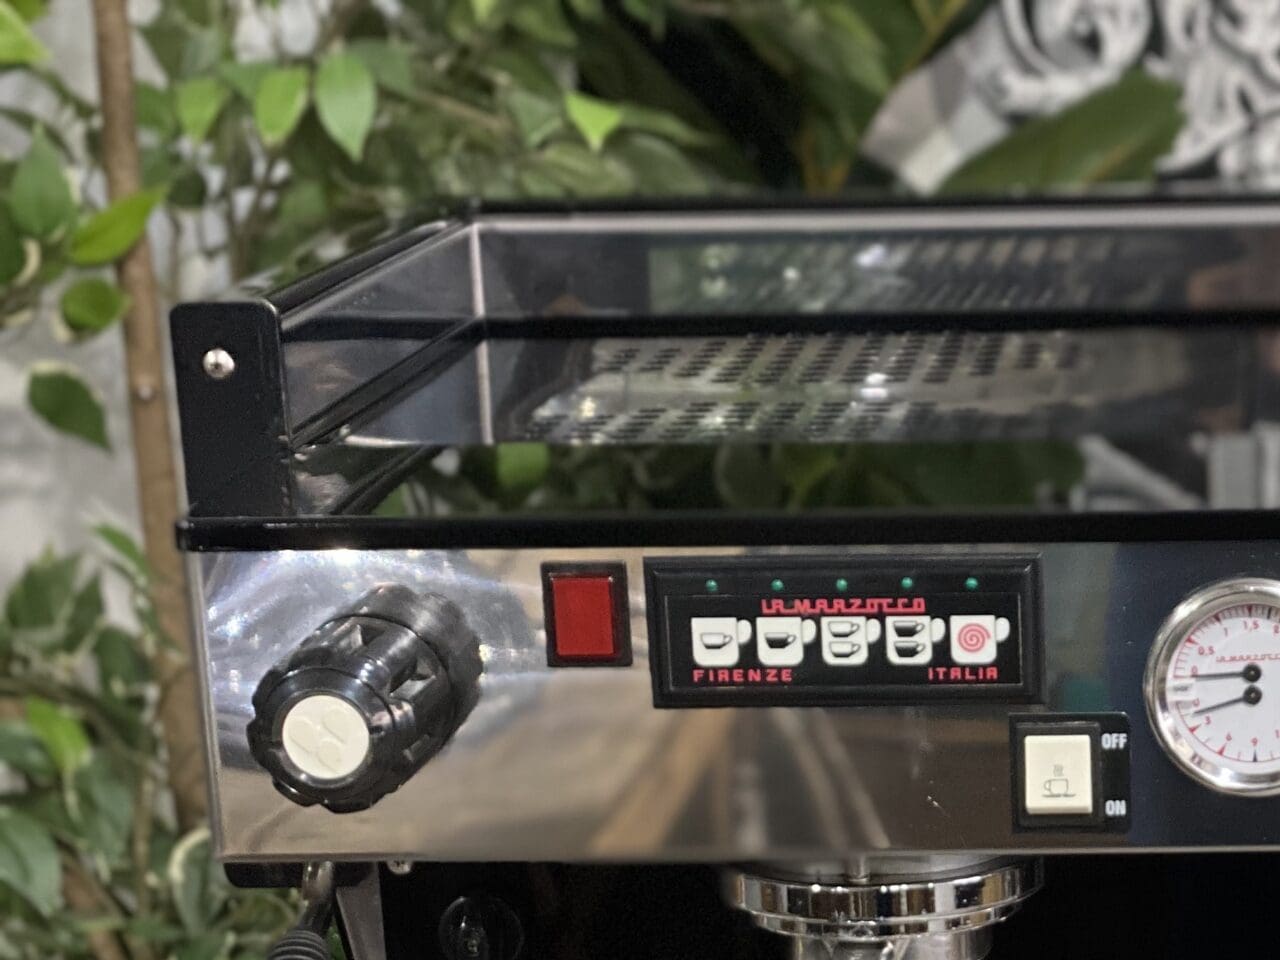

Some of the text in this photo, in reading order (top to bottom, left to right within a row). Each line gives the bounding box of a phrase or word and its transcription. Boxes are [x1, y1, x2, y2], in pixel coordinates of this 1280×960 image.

[692, 668, 793, 683] FIRENZE
[927, 666, 999, 682] ITALIA
[1101, 733, 1128, 750] OFF
[1104, 799, 1127, 817] ON
